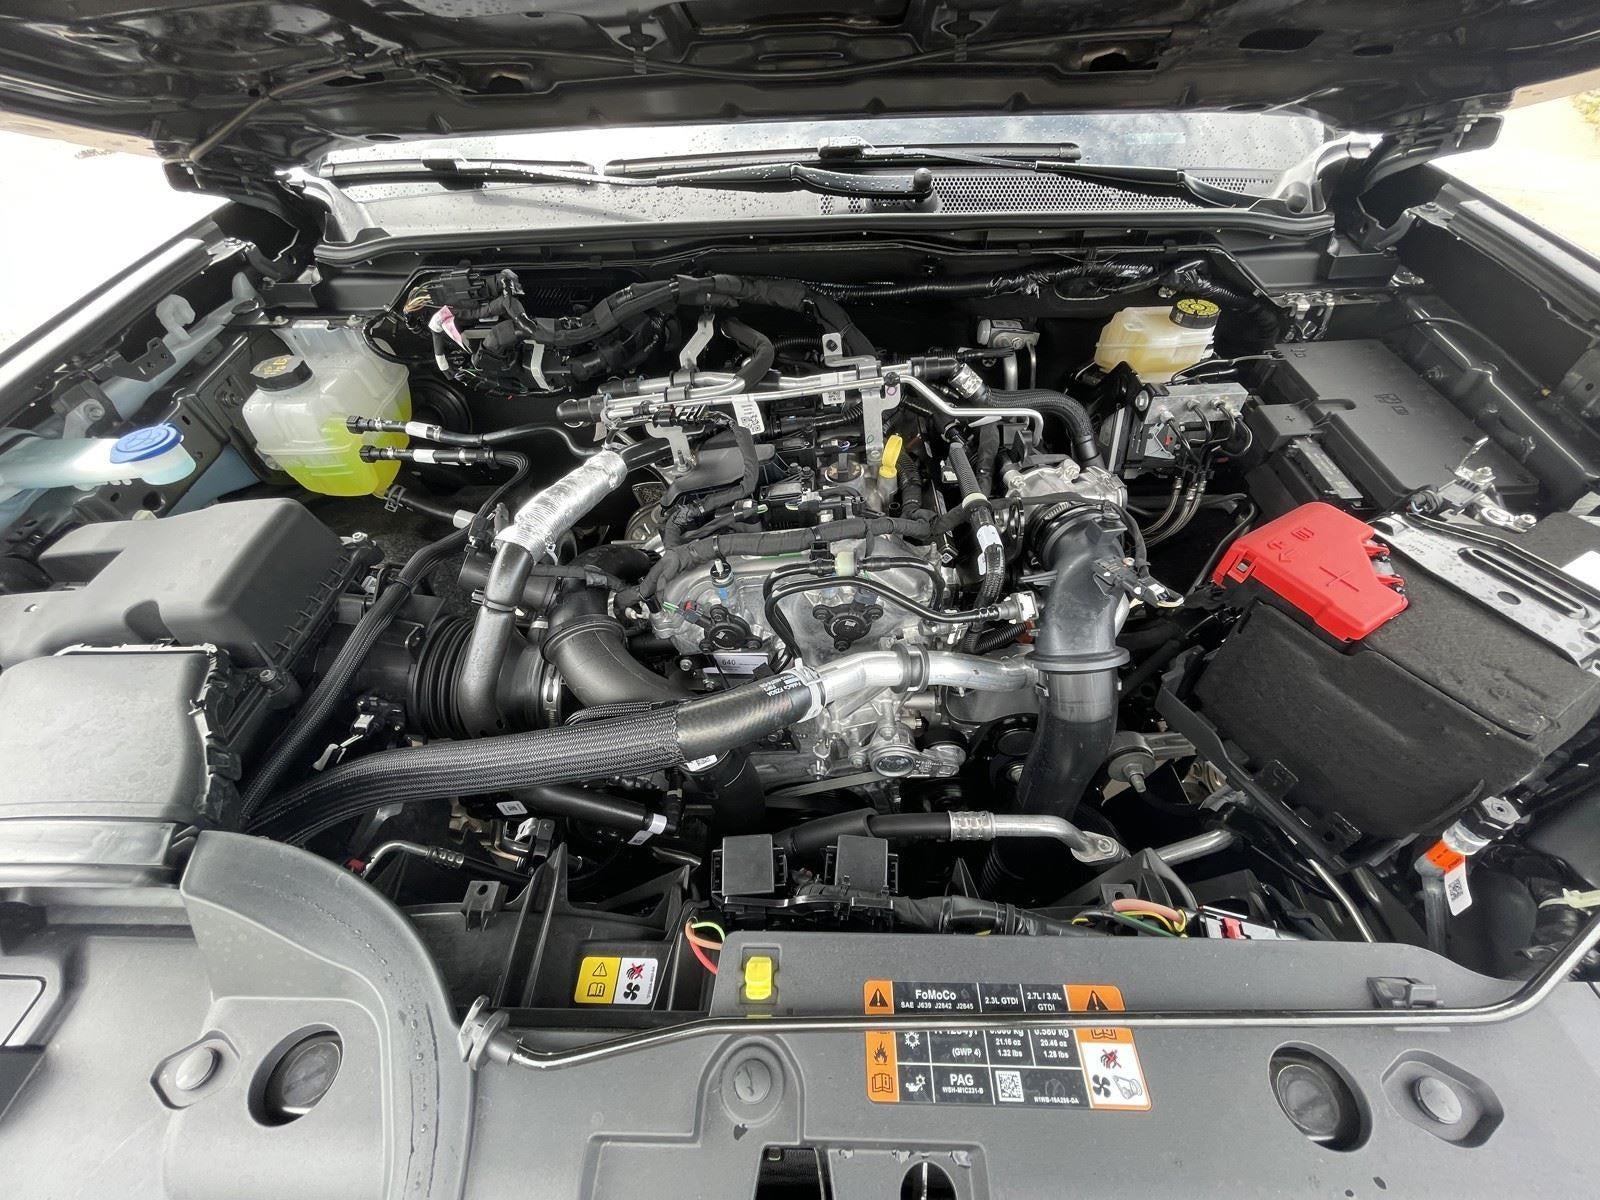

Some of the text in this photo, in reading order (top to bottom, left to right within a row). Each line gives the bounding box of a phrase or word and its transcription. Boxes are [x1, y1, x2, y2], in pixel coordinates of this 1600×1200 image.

[915, 989, 957, 1001] FoMoCo
[1027, 992, 1042, 1000] 2.7L
[1047, 993, 1062, 1001] 3.0L
[901, 1001, 915, 1009] SAE
[917, 1001, 932, 1009] J639
[985, 997, 1019, 1005] 2.3L GTDI
[1038, 1003, 1056, 1012] GTDI
[952, 1047, 982, 1058] (GWP 4)
[1012, 1049, 1023, 1057] lbs
[1058, 1051, 1069, 1059] lbs
[950, 1073, 974, 1086] PAG
